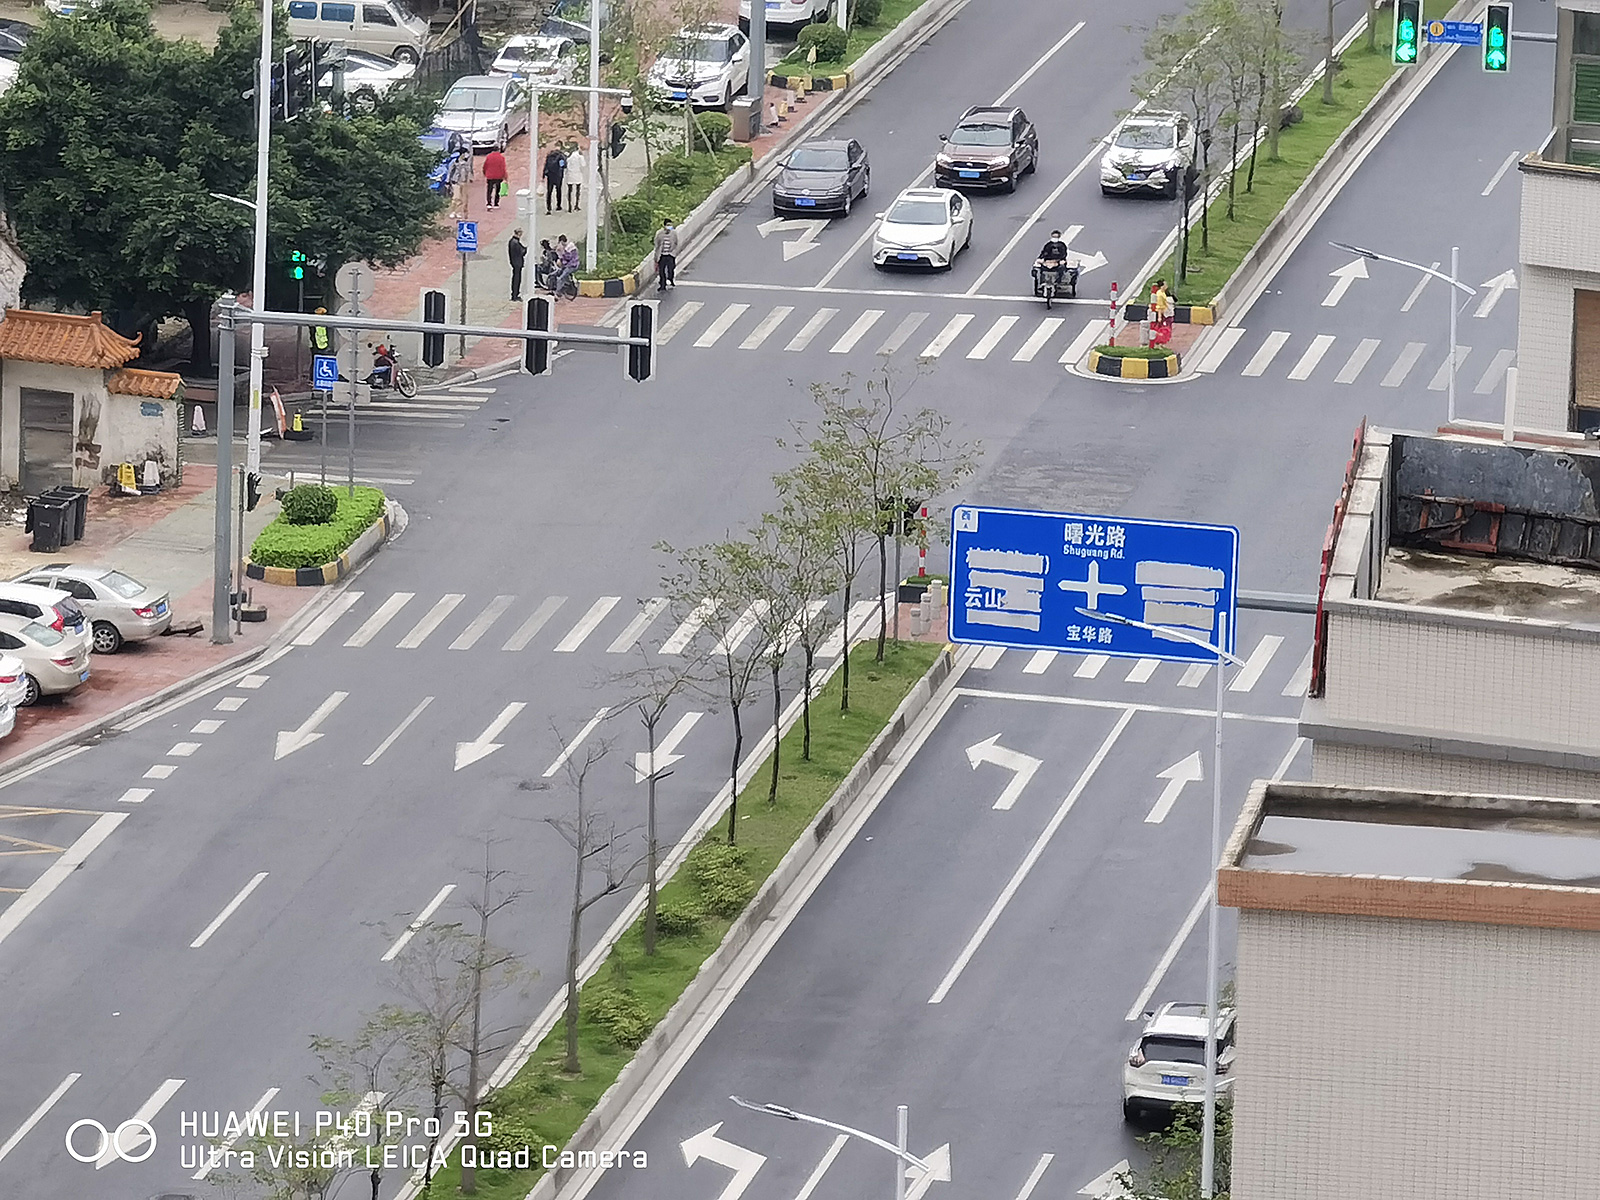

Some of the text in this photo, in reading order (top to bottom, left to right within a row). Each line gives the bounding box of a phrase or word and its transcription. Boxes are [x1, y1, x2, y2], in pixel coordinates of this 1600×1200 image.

[1064, 522, 1126, 548] 曙光路
[1063, 544, 1126, 560] Shuguang Rd.
[1066, 624, 1113, 645] 宝华路
